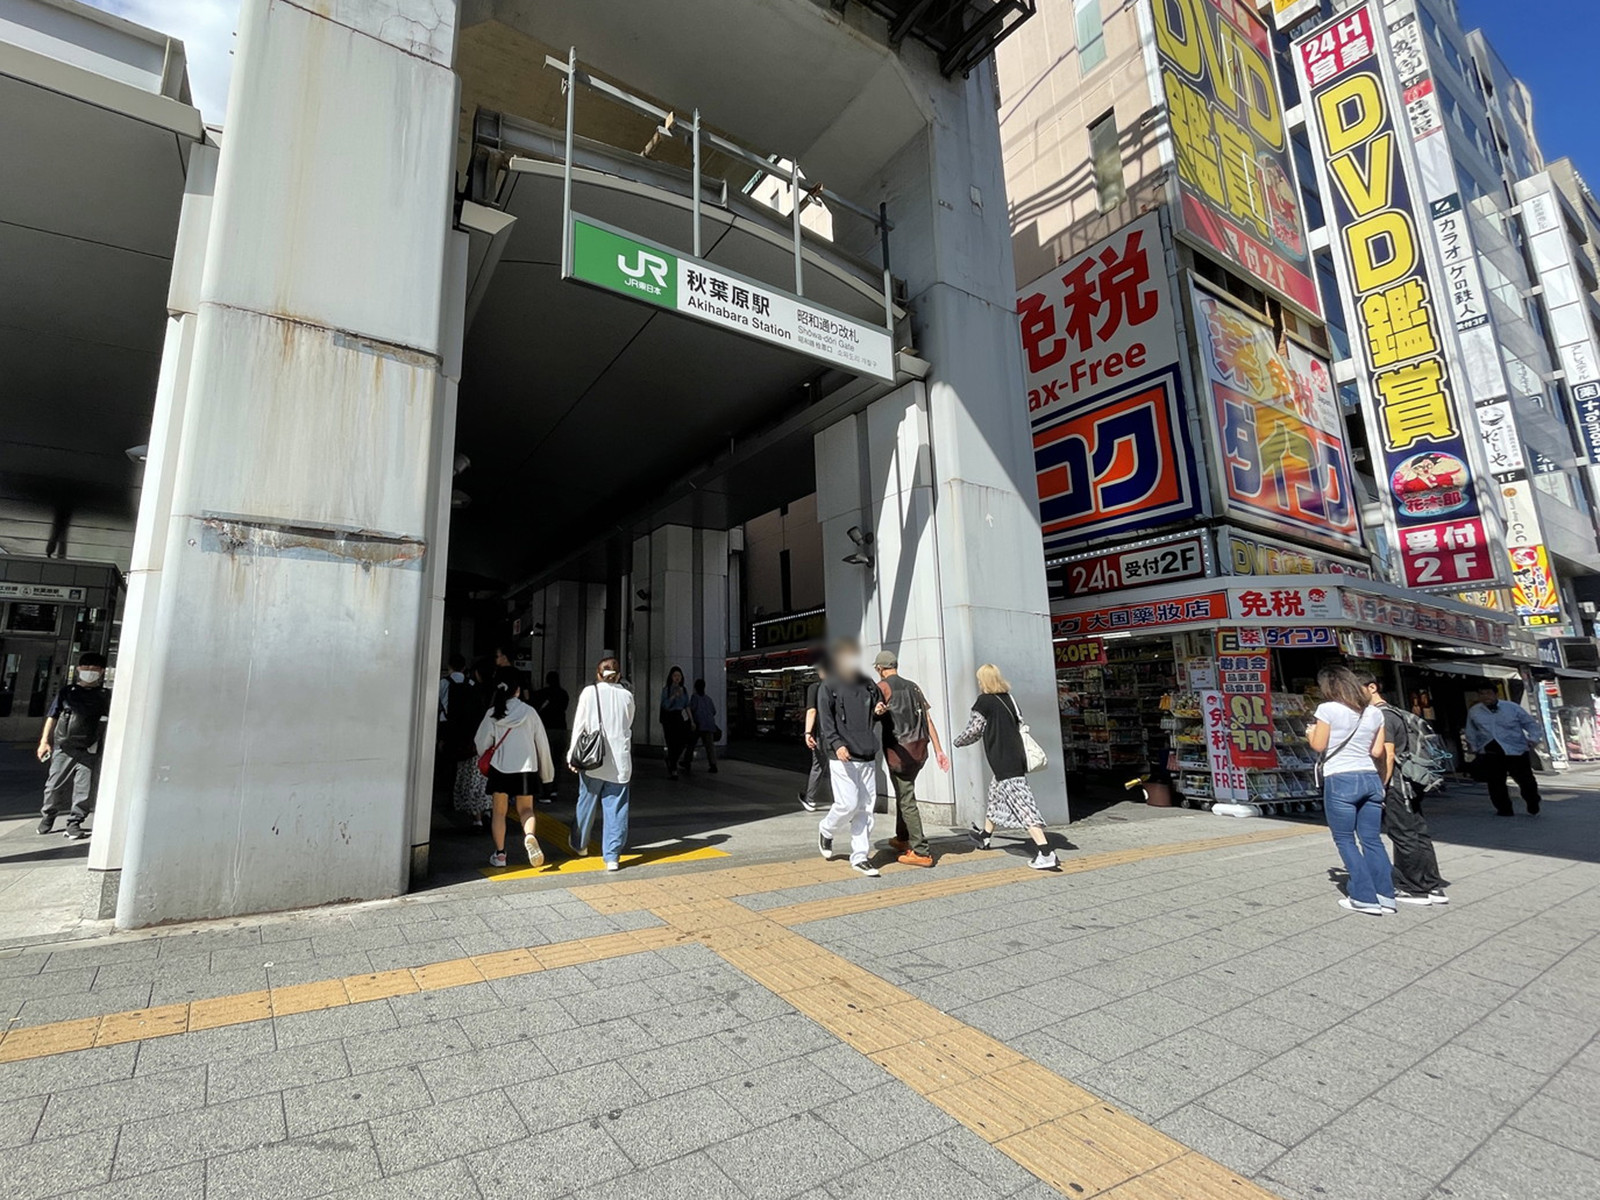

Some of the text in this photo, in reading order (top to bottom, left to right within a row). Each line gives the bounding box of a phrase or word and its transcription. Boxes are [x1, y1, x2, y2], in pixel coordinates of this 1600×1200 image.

[1305, 14, 1363, 64] 24H
[1152, 0, 1284, 148] DVD
[1309, 35, 1371, 84] 営業
[617, 249, 668, 288] JR
[1439, 218, 1476, 318] カラオケの鉄人
[686, 268, 770, 318] 秋葉原駅
[687, 295, 792, 340] Akihabara Station
[797, 308, 860, 344] 昭和通り改札
[1498, 472, 1516, 483] 1F
[1405, 523, 1477, 556] 受付
[1072, 546, 1195, 594] 24h 受付2F
[1413, 552, 1477, 583] 2F
[1239, 589, 1305, 618] 免税
[1266, 626, 1331, 645] ダイコク
[1214, 772, 1246, 790] FREE
